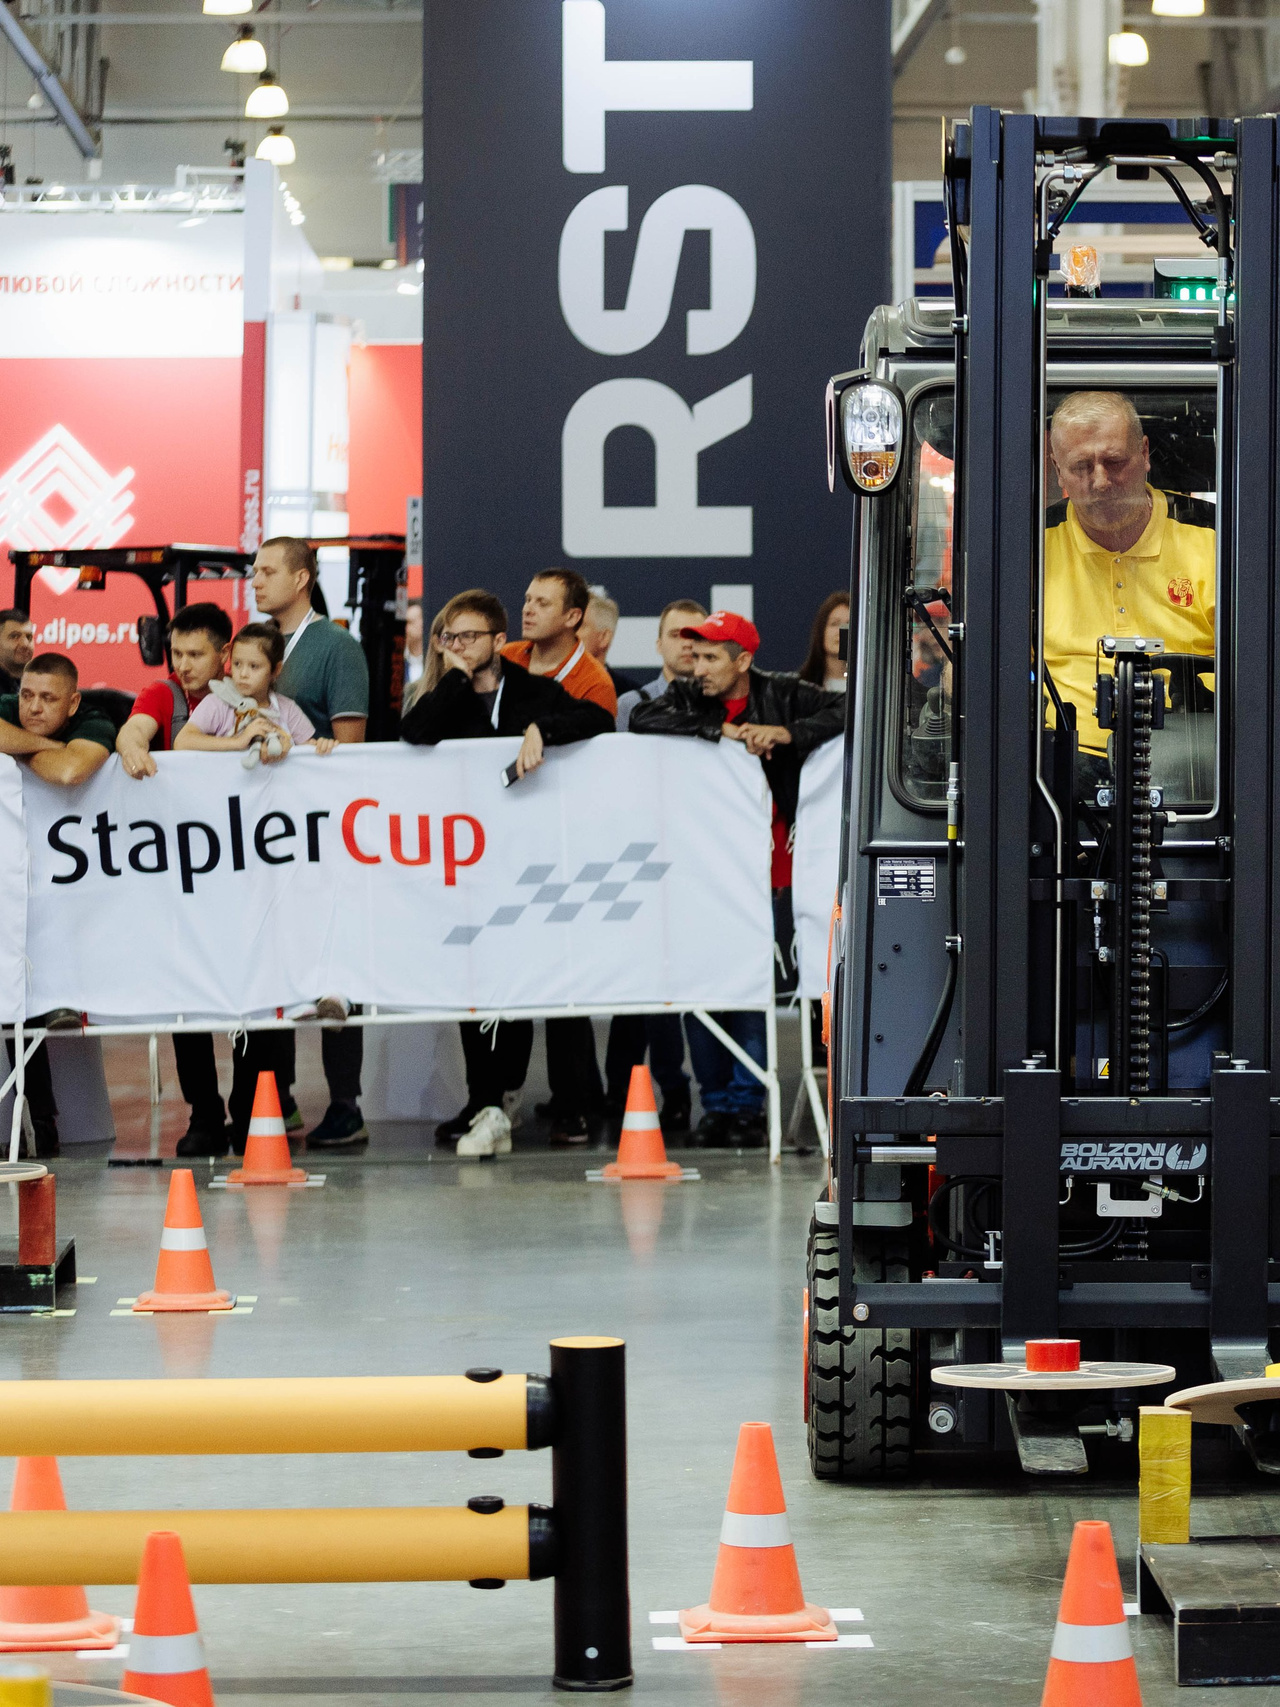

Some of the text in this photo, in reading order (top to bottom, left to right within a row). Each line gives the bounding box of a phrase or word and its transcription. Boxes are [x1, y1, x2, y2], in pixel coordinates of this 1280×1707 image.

[0, 274, 83, 294] ЛЮБОЙ
[47, 795, 486, 894] StaplerCup
[1060, 1142, 1167, 1157] BOLZONI
[1059, 1157, 1164, 1171] AURAMO
